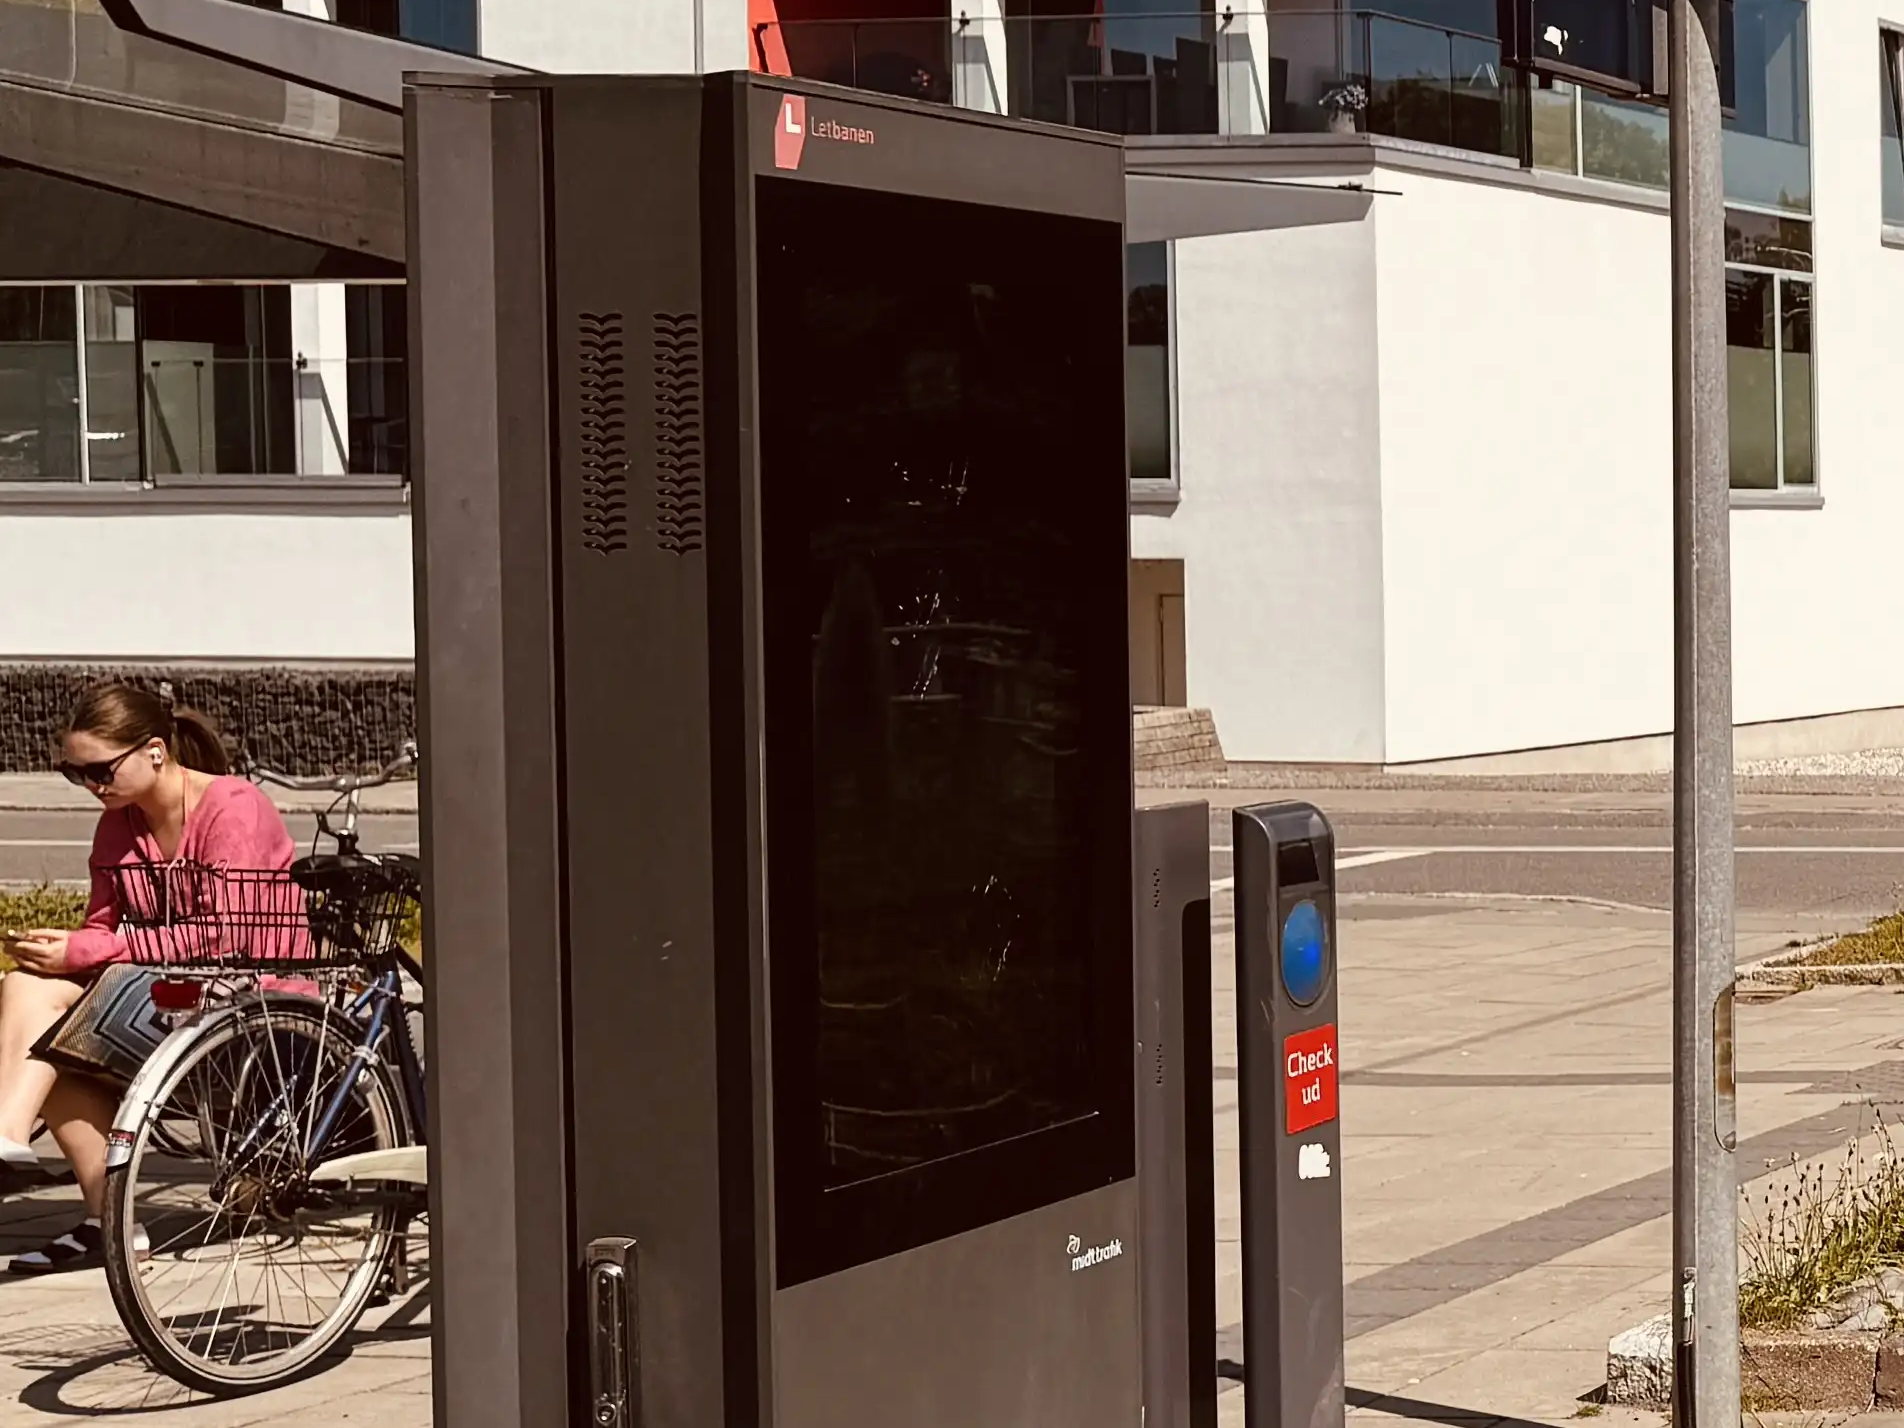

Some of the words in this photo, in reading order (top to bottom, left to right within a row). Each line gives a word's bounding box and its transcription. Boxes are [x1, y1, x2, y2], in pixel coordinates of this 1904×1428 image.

[810, 115, 875, 145] Letbanen
[1287, 1042, 1334, 1078] Check
[1301, 1077, 1321, 1105] ud
